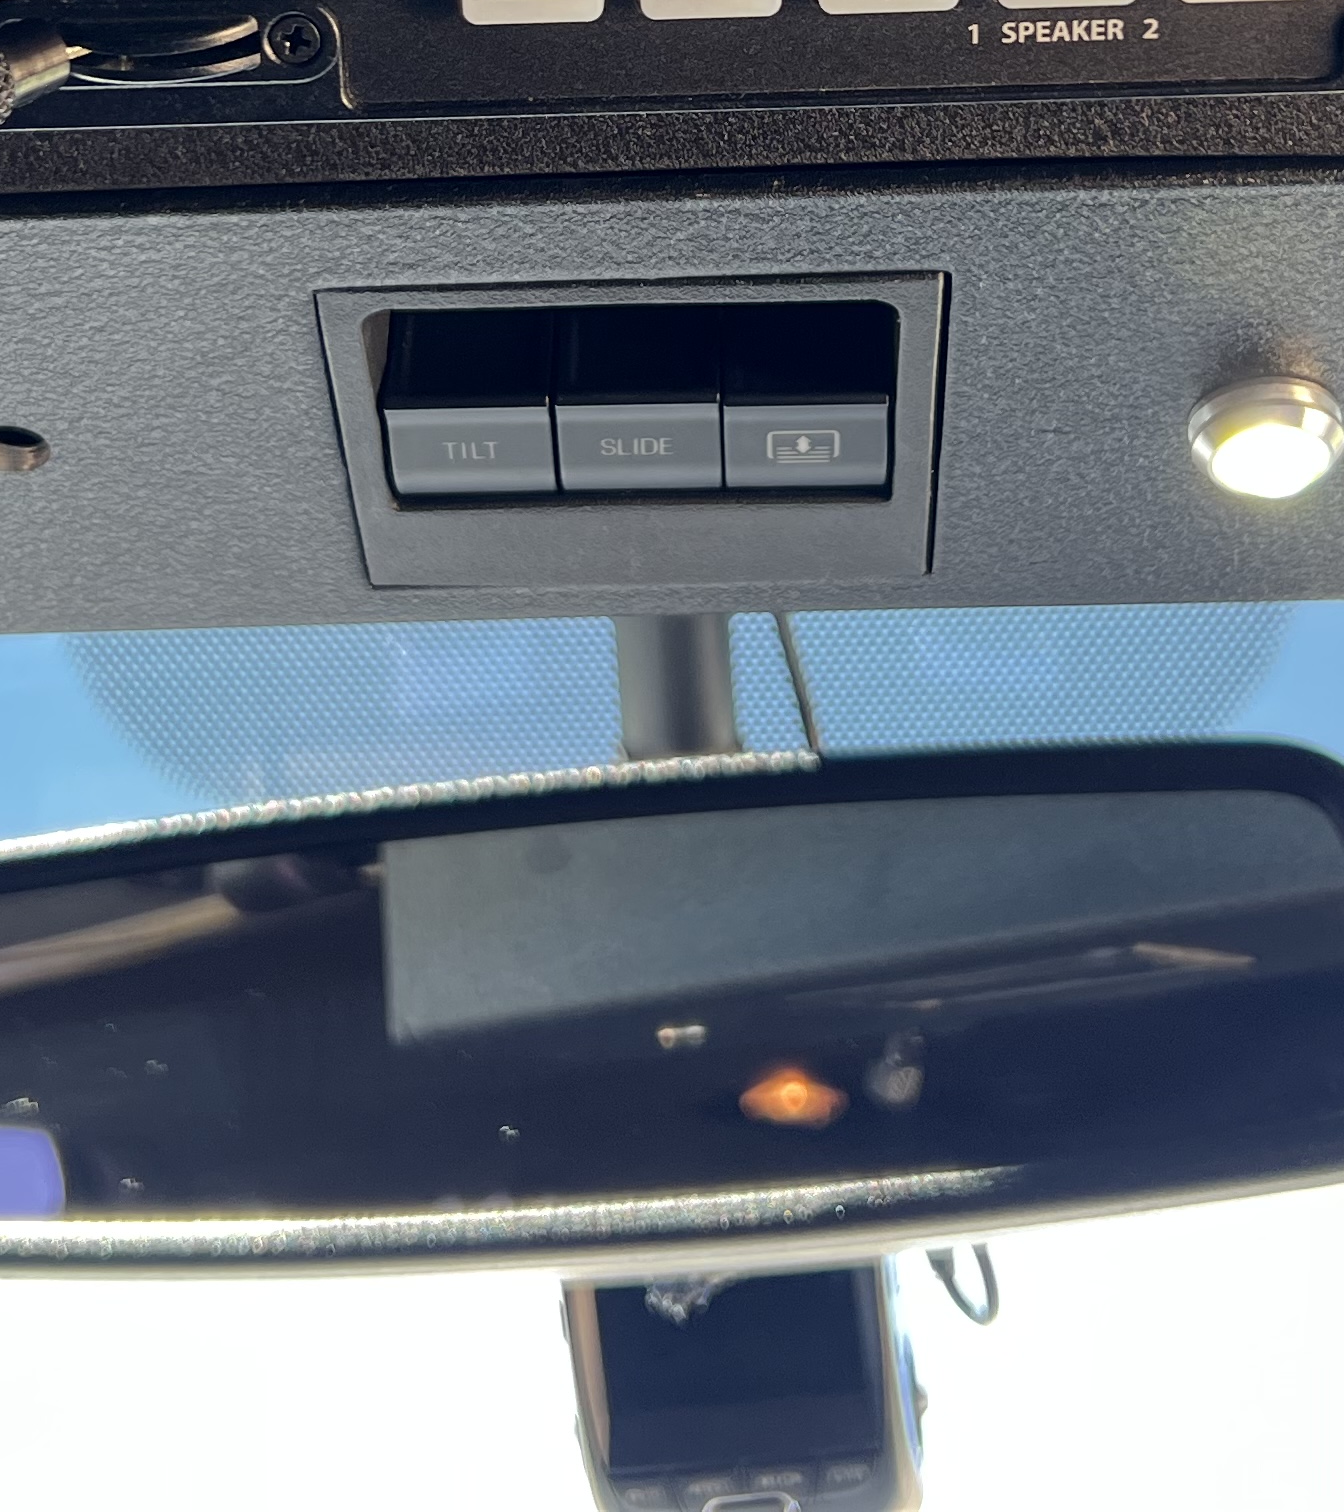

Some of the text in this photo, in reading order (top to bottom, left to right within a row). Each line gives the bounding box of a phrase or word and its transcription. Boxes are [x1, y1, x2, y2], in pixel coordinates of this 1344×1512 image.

[967, 18, 1159, 45] 1 SPEAKER 2
[442, 441, 498, 460] TILT
[600, 437, 673, 456] SLIDE
